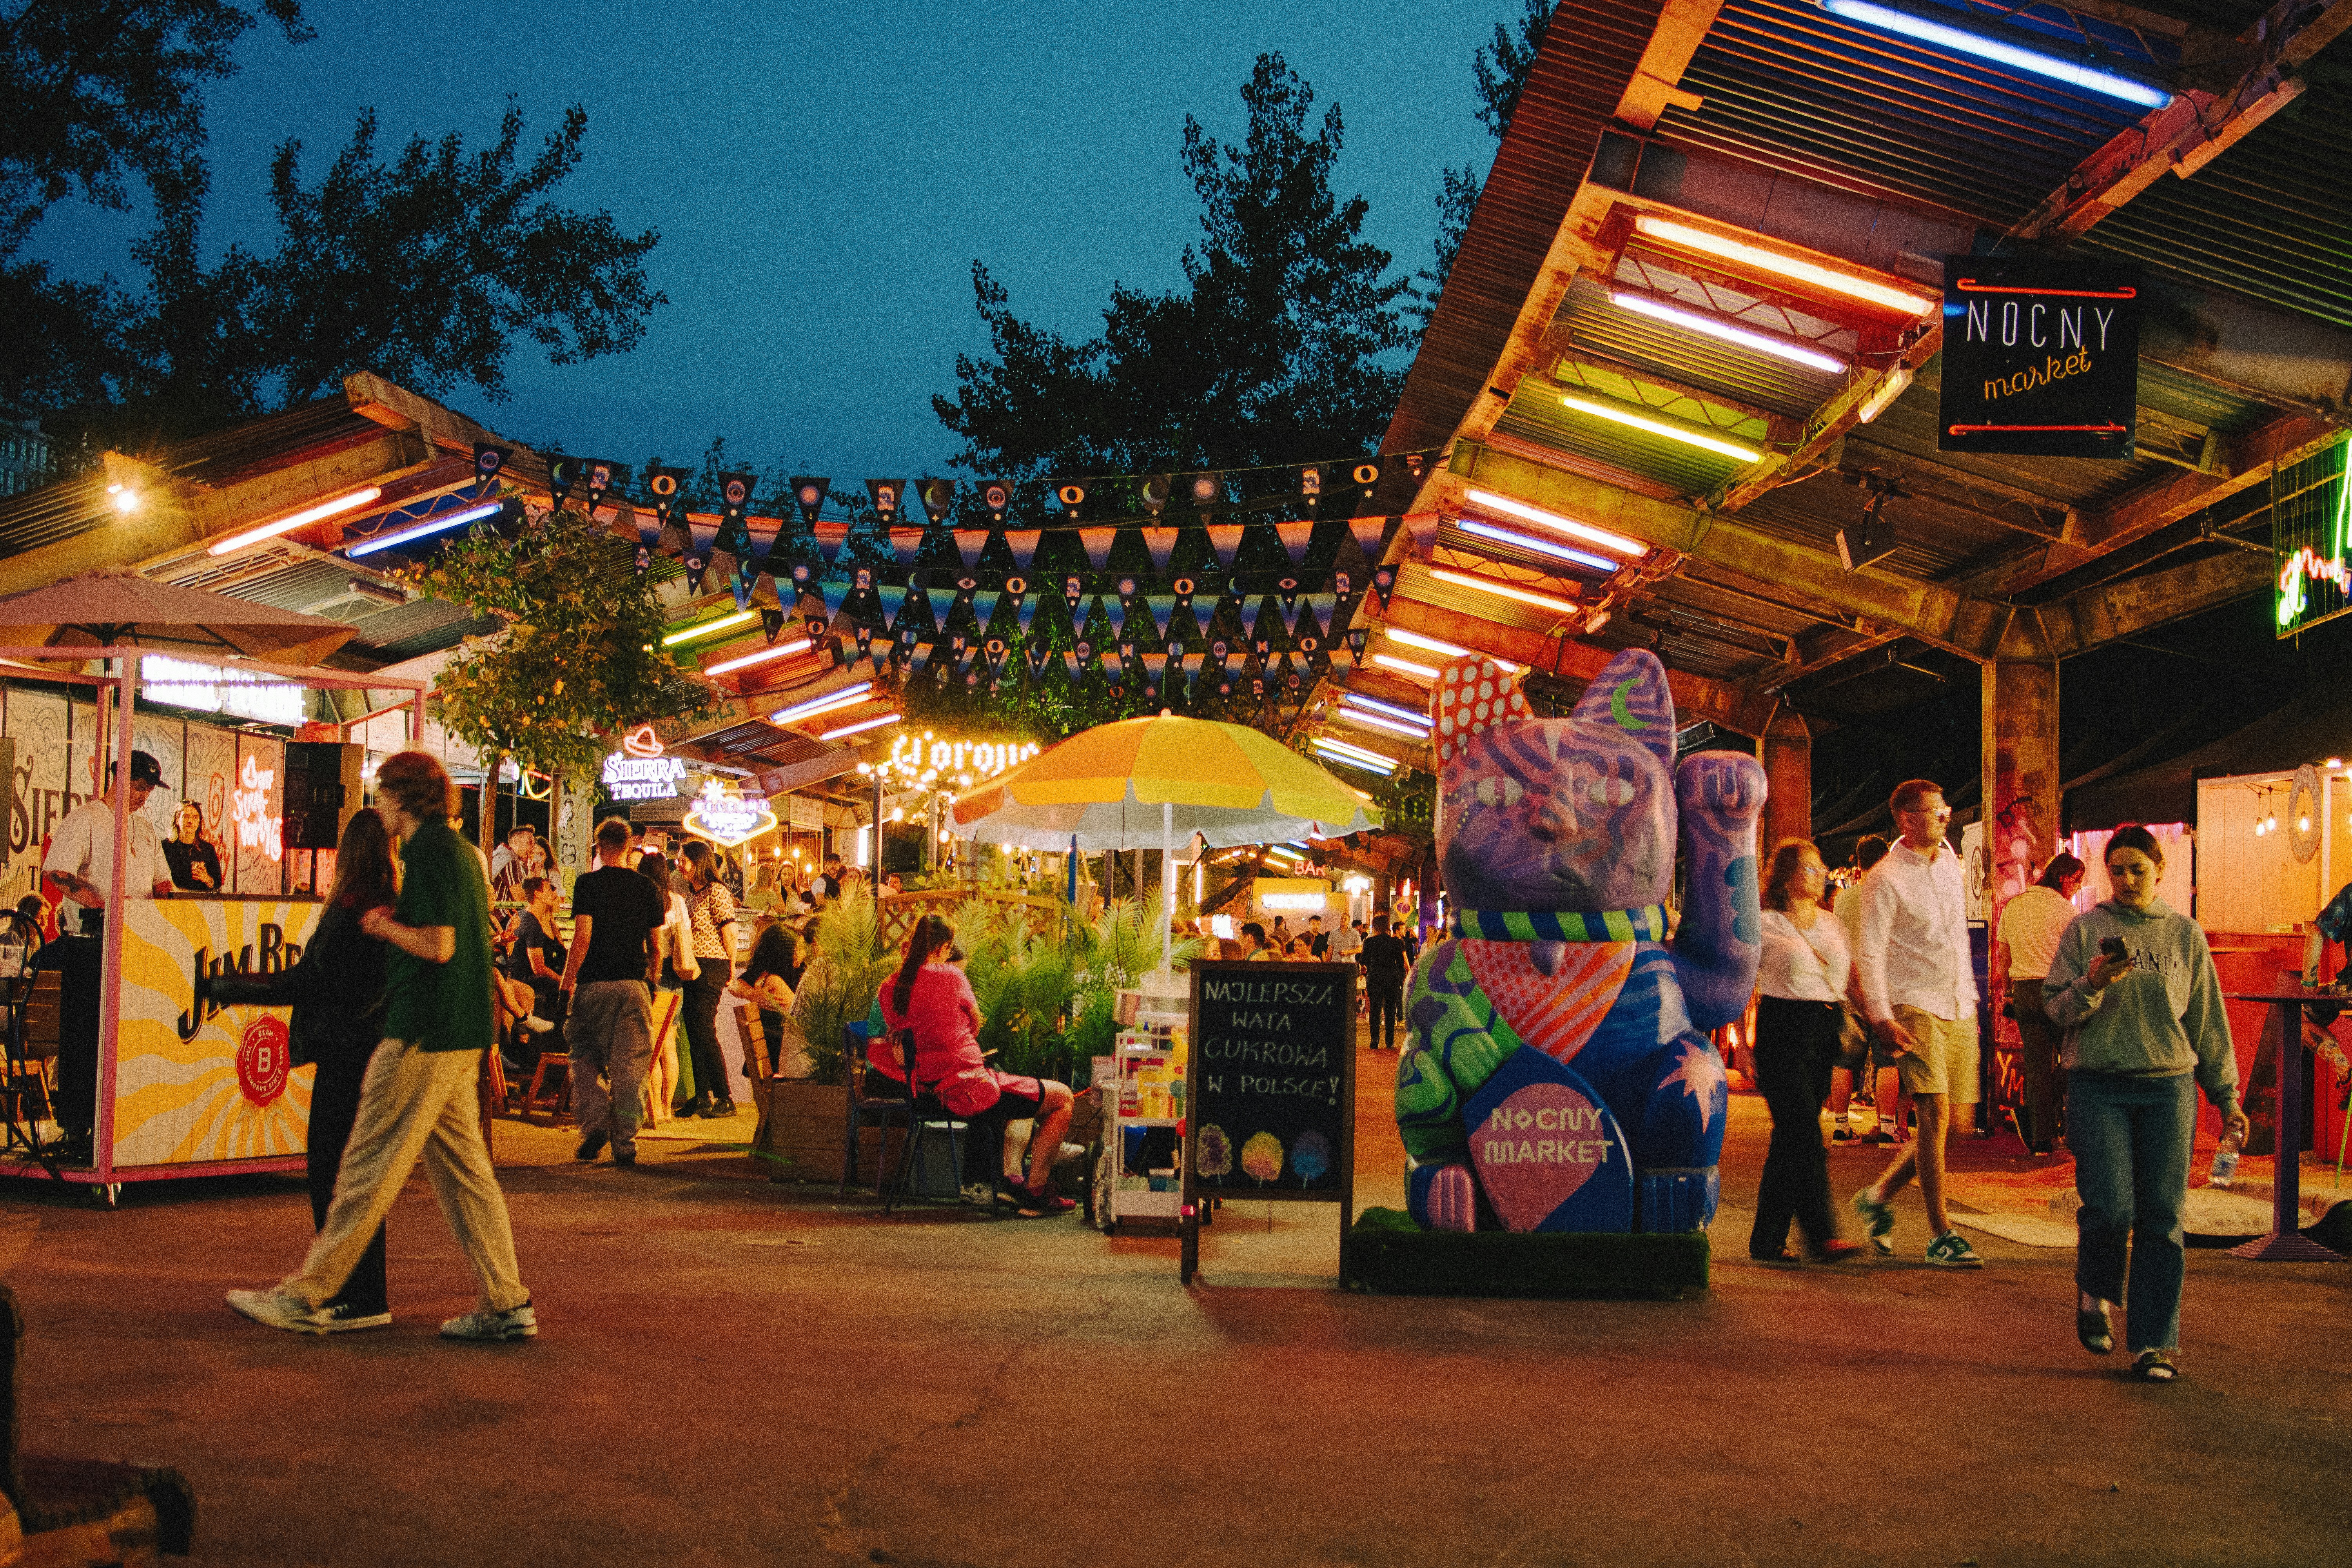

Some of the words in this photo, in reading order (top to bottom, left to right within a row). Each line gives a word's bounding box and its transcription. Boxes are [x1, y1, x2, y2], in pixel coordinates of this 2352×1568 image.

[1967, 300, 2113, 350] NOCNY
[1984, 345, 2092, 400] market
[603, 751, 687, 784] SIERRA
[610, 782, 678, 800] TEQUILA
[1205, 981, 1332, 1006] NAJLEPSZA
[258, 1029, 274, 1038] BEAM
[1232, 1012, 1291, 1031] WATA
[257, 1047, 271, 1073] B
[1205, 1037, 1327, 1068] CUKROWA
[1208, 1075, 1223, 1093] W
[1241, 1075, 1340, 1105] POLSCE!
[1492, 1108, 1603, 1131] NOCNY
[1485, 1140, 1614, 1164] MARKET
